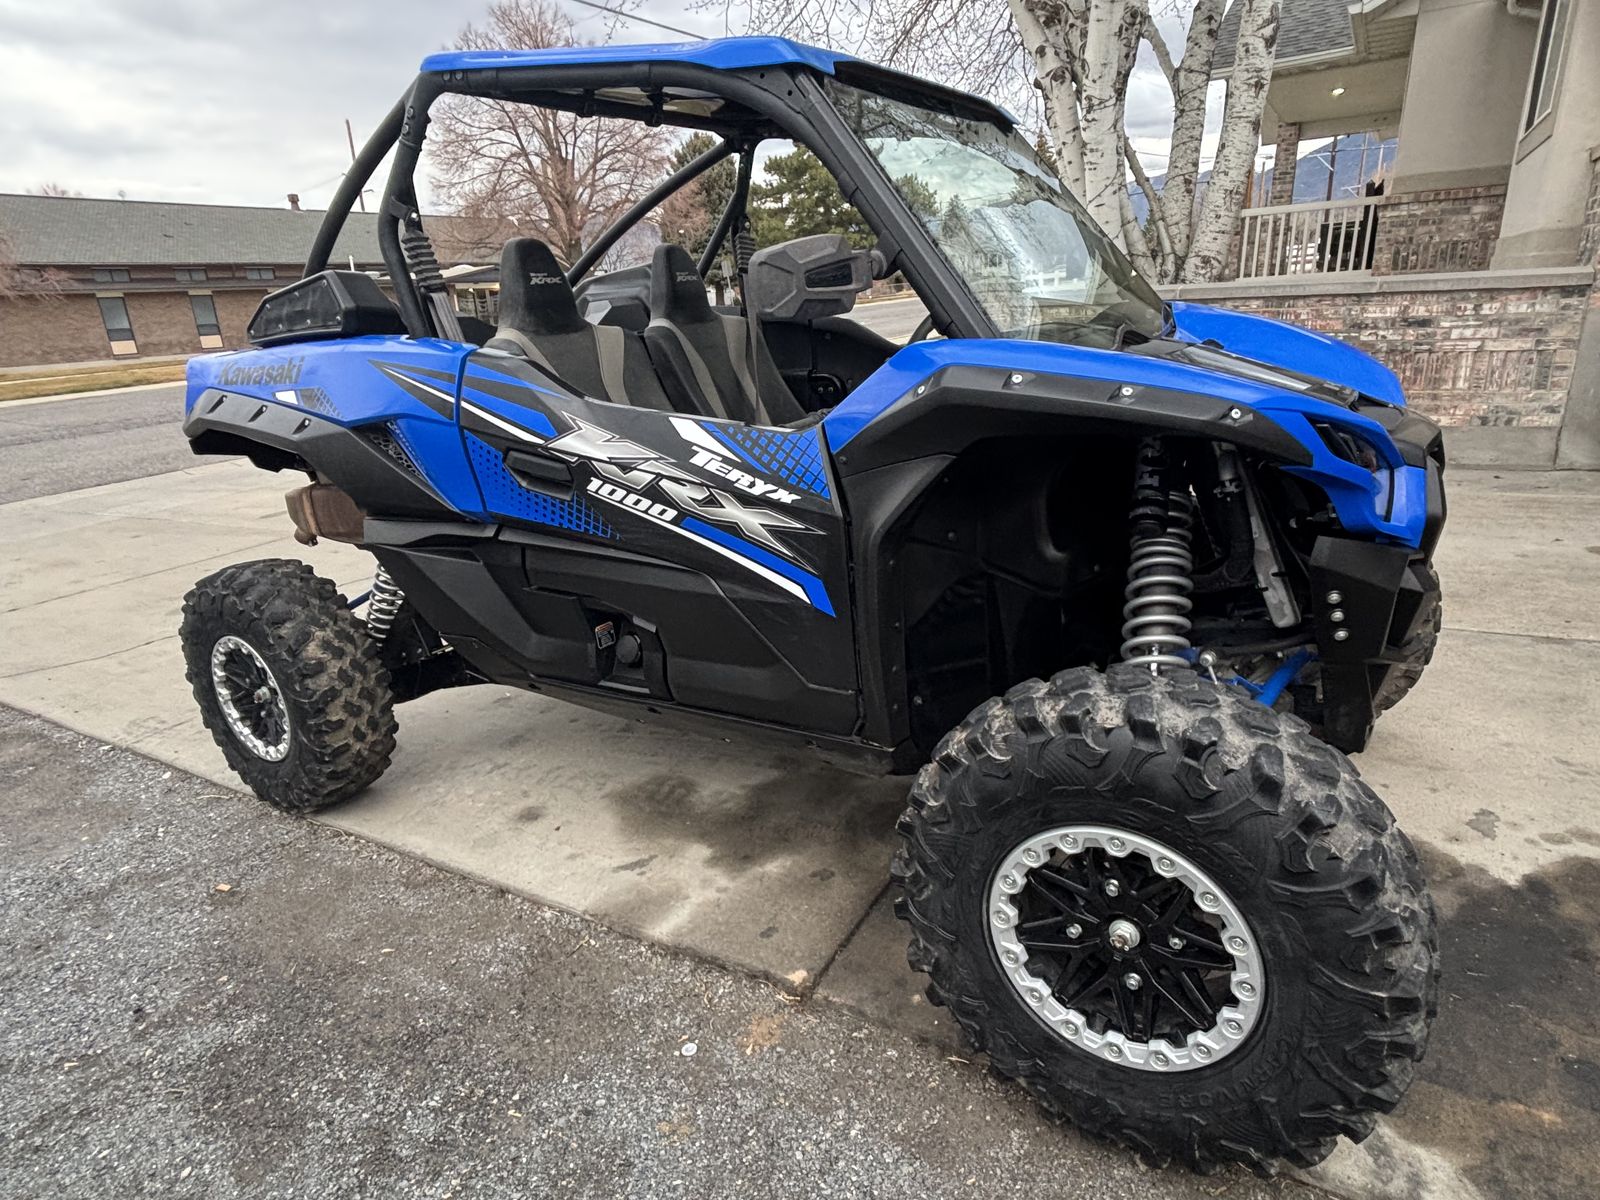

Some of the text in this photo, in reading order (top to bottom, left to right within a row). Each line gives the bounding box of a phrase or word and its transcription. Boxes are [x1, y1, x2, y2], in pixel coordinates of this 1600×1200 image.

[530, 277, 563, 285] KRX
[217, 356, 304, 385] Kawasaki
[547, 411, 826, 574] KRX
[688, 445, 802, 504] TERYX
[586, 477, 679, 522] 1000
